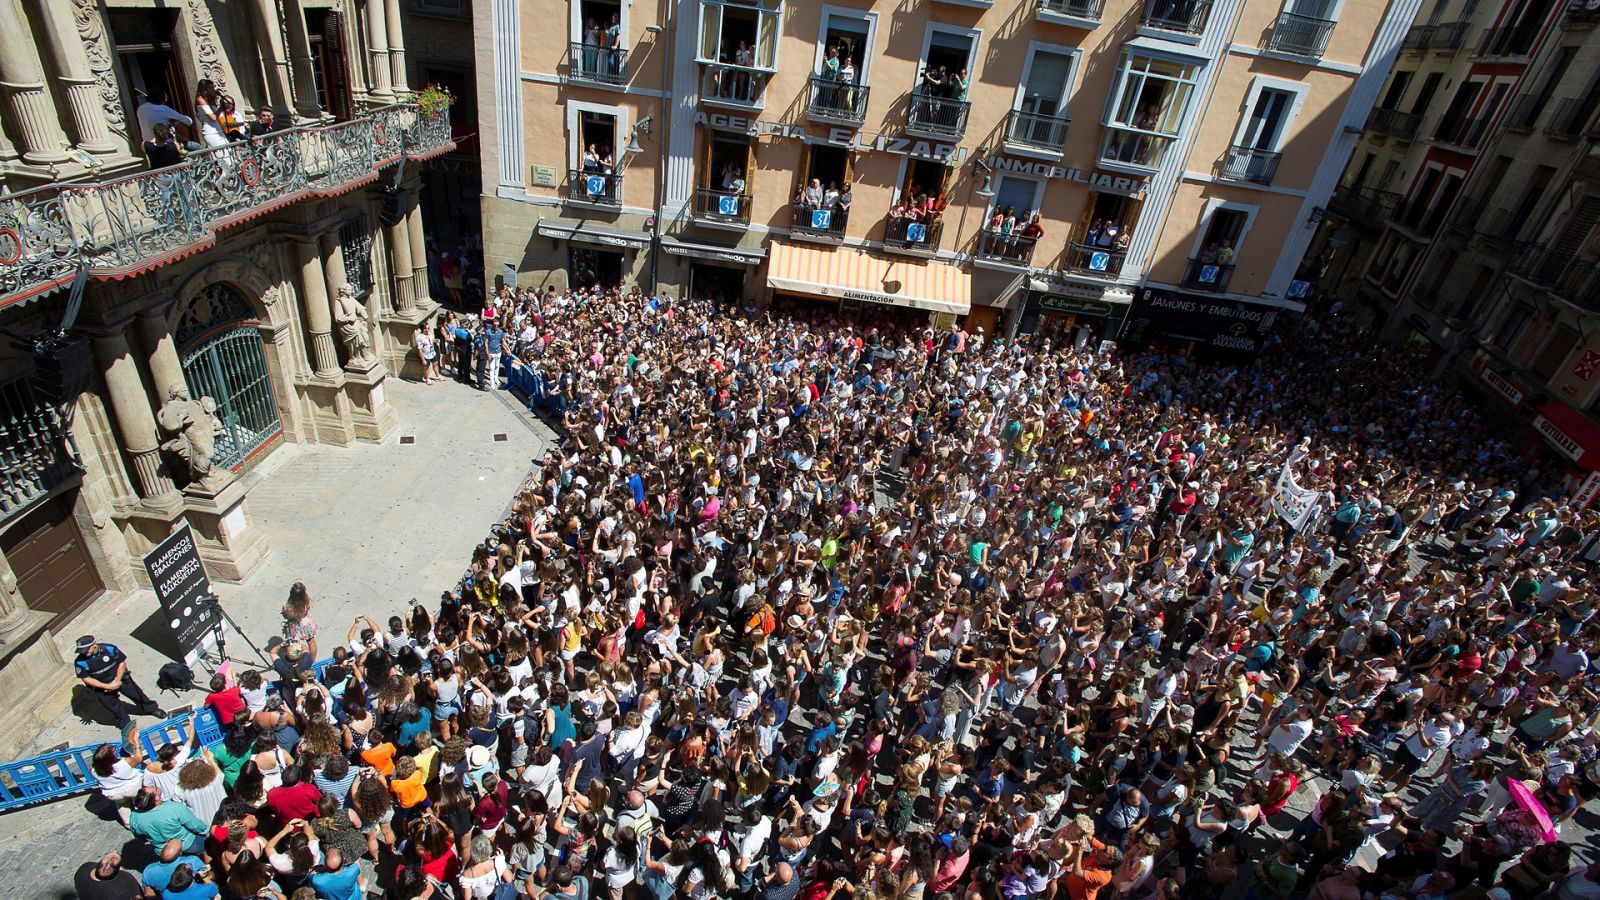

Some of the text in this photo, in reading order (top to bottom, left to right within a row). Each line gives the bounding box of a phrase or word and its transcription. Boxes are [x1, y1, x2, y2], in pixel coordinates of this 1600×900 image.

[694, 111, 1152, 194] AGENCIA ELIZARI INMOBILIARIA
[1150, 296, 1197, 312] JAMONES
[1199, 303, 1208, 313] Y
[151, 538, 186, 571] FLAMENCO
[158, 543, 193, 574] BALCONES
[160, 558, 198, 592] FLAMENKOA
[162, 562, 200, 598] BALKOIETAN
